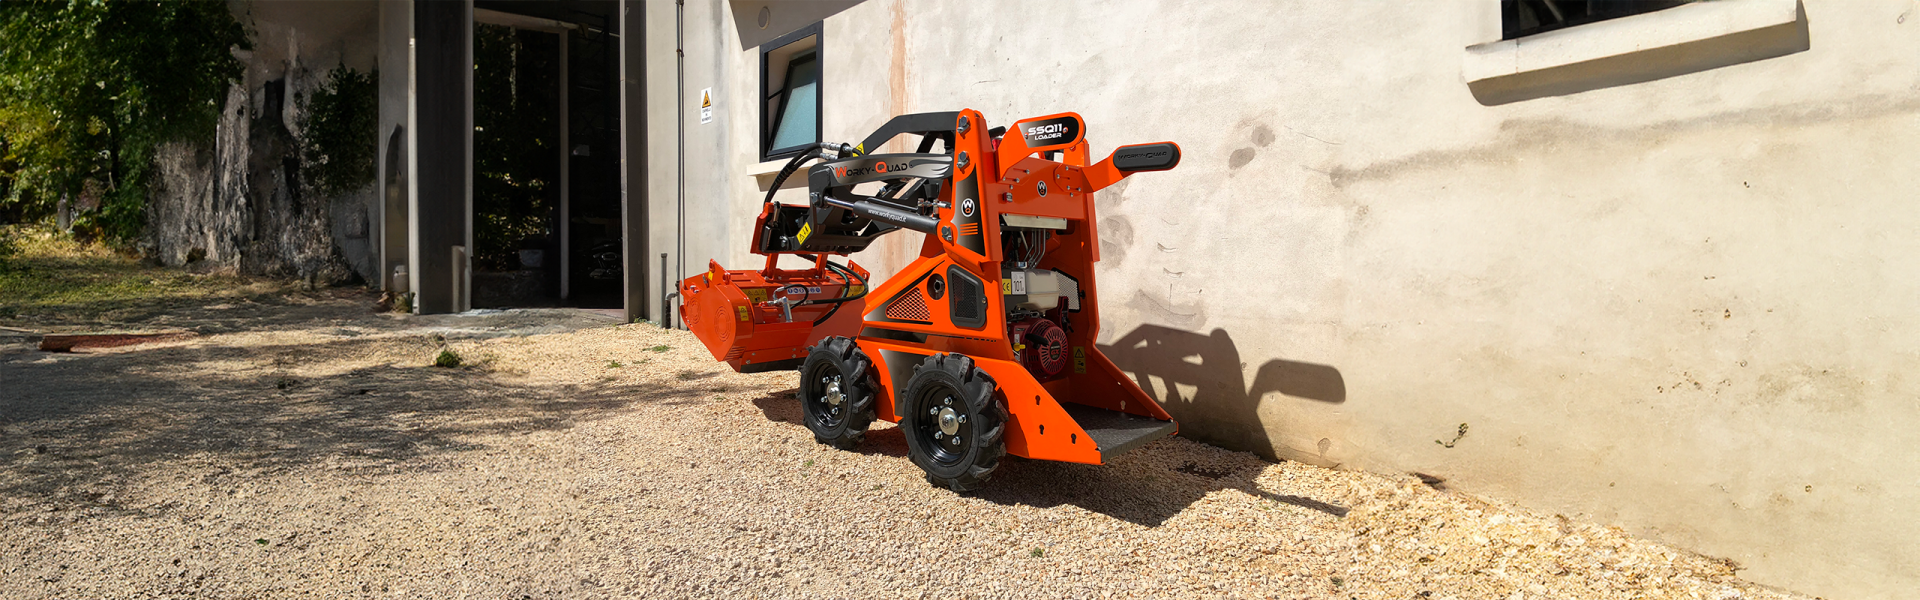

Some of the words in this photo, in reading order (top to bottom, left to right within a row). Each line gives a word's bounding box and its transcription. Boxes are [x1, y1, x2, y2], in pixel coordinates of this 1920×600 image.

[1028, 123, 1062, 136] SSQ11
[1034, 132, 1062, 141] LOADER
[835, 161, 908, 178] WORKY-QUAD
[867, 209, 907, 223] www.workyquad.it
